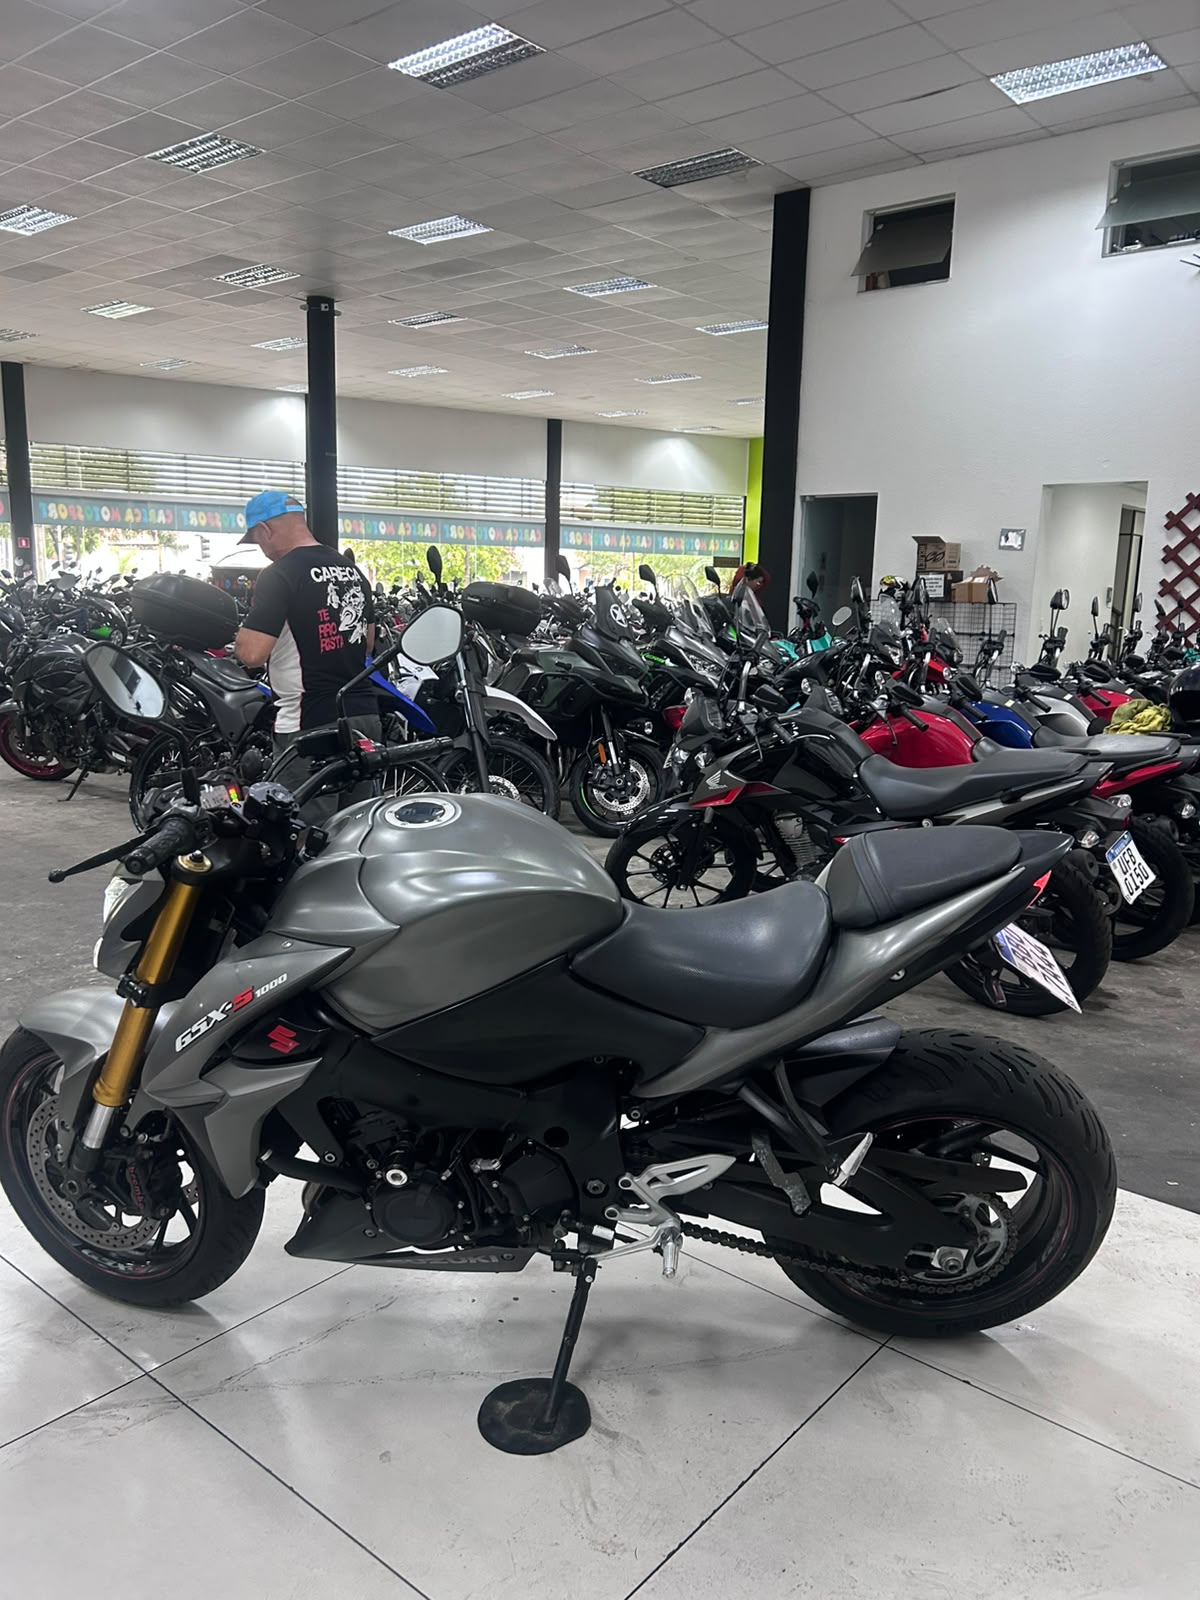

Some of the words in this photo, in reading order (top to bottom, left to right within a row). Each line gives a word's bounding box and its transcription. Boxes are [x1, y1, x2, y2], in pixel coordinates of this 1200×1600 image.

[310, 566, 362, 583] CARECA
[317, 609, 330, 621] TE
[1117, 847, 1137, 876] UFB
[255, 973, 287, 998] 1000
